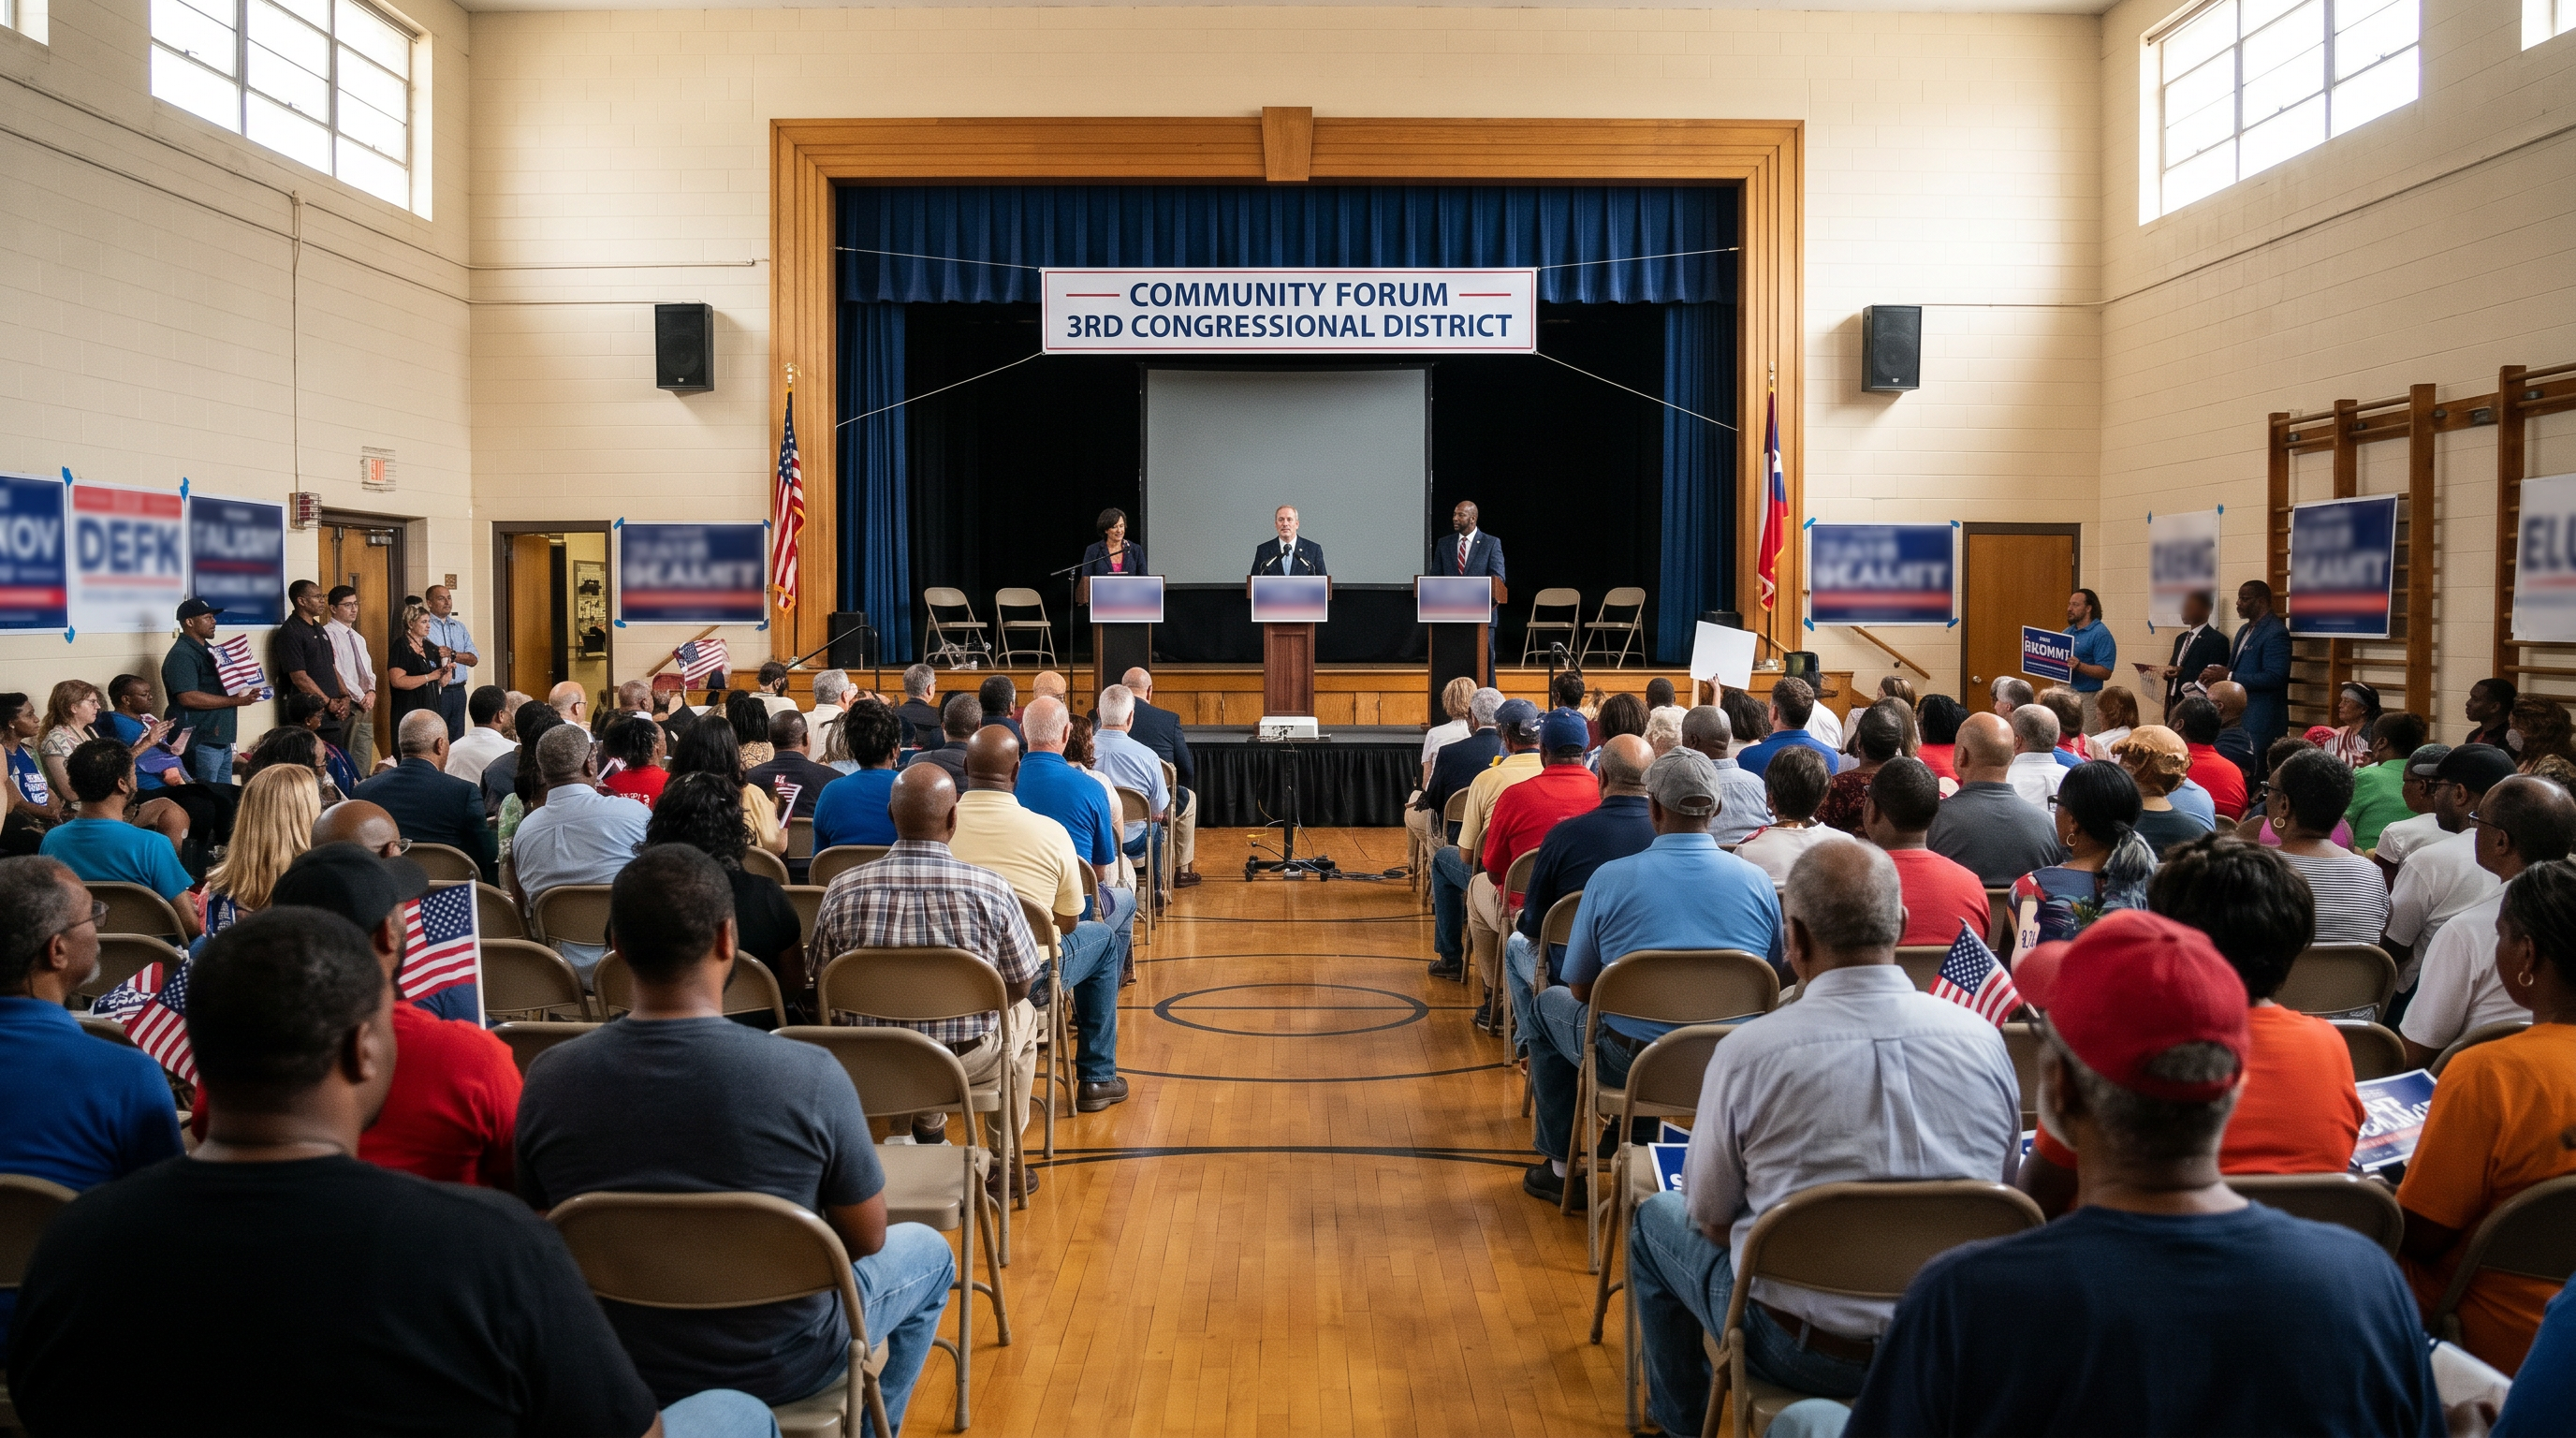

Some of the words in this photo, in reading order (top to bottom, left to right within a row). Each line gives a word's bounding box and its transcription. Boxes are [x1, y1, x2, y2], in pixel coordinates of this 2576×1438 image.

[1130, 282, 1327, 307] COMMUNITY
[1336, 282, 1448, 307] FORUM
[1066, 315, 1123, 338] 3RD
[1131, 314, 1376, 338] CONGRESSIONAL
[1383, 314, 1513, 338] DISTRICT
